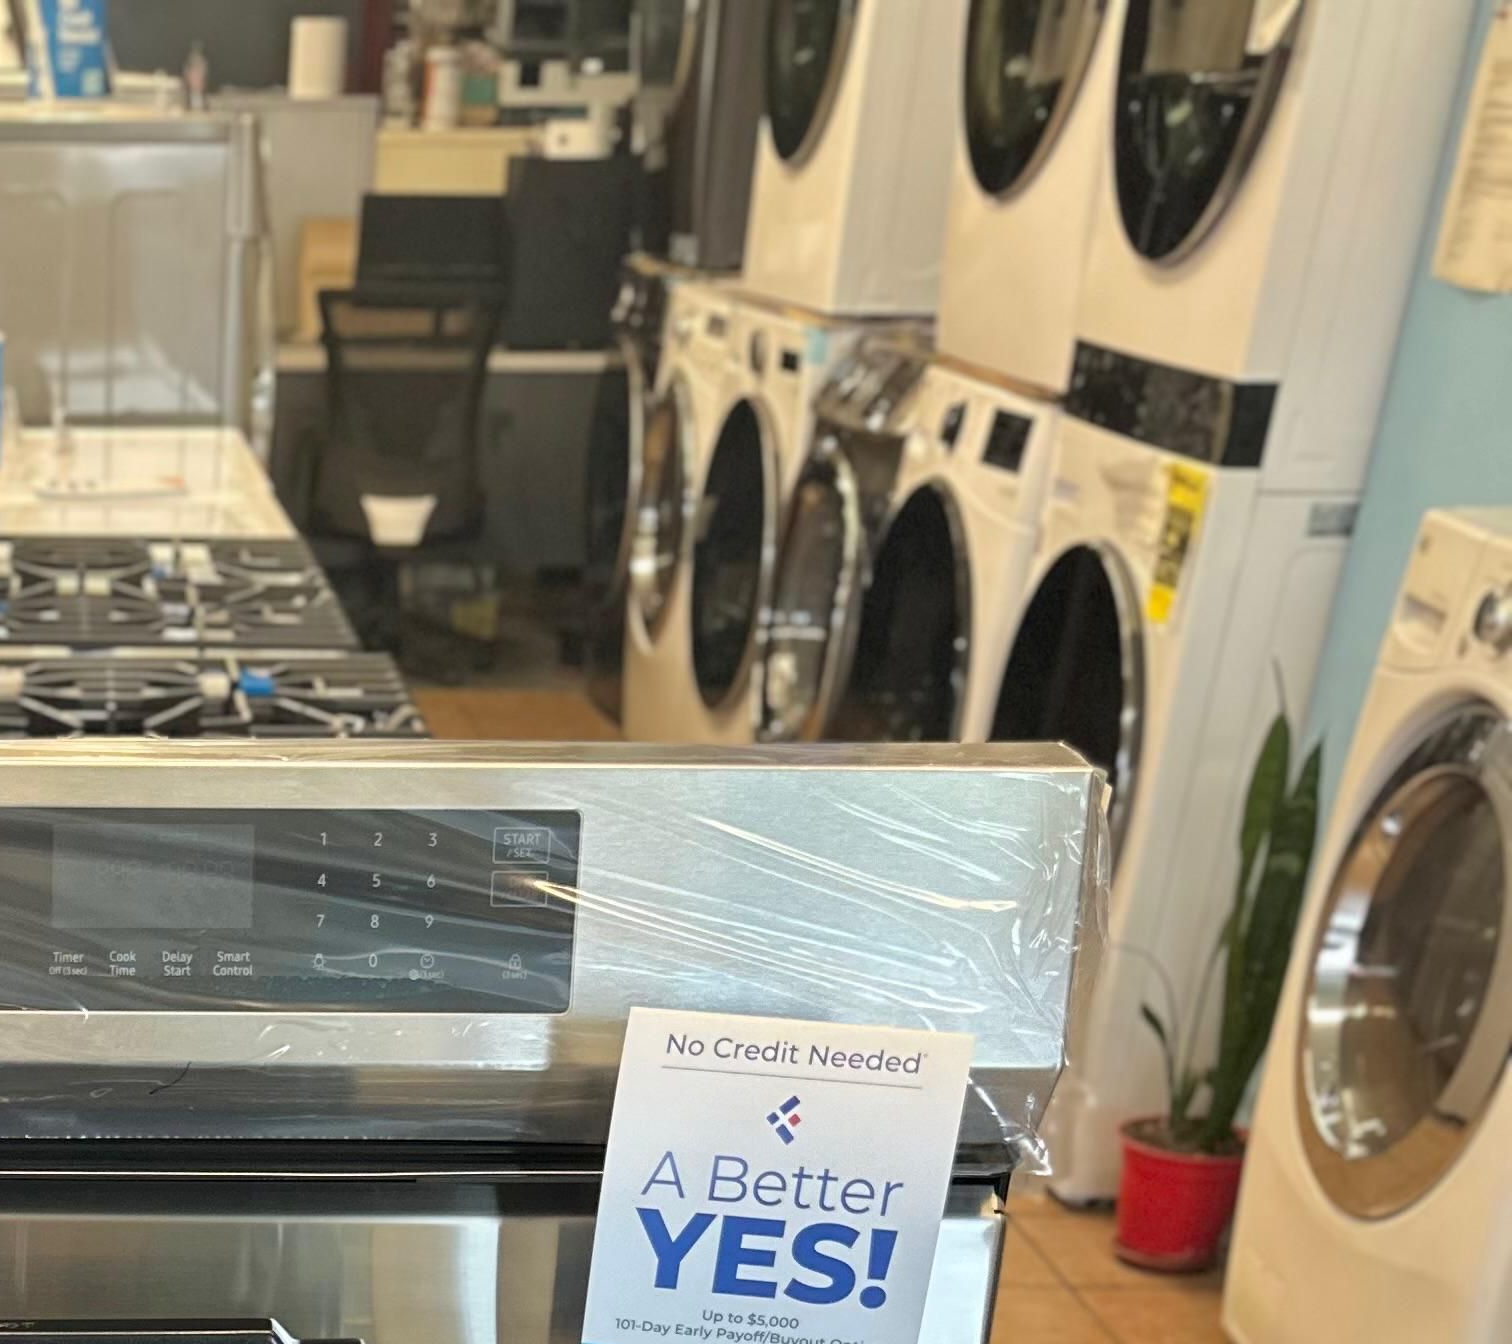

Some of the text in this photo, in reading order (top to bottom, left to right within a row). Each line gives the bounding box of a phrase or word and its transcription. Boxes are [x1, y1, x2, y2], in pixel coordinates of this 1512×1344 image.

[320, 833, 327, 846] 1
[373, 833, 382, 847] 2
[427, 833, 437, 847] 3
[503, 832, 541, 845] START
[317, 874, 326, 888] 4
[372, 874, 381, 888] 5
[426, 874, 436, 889] 6
[316, 915, 325, 928] 7
[370, 915, 379, 929] 8
[425, 915, 434, 929] 9
[52, 951, 84, 964] Timer
[109, 950, 137, 963] Cook
[161, 951, 193, 965] Delay
[216, 950, 250, 963] Smart
[368, 954, 377, 968] 0
[109, 964, 137, 976] Time
[163, 965, 191, 977] Start
[212, 964, 253, 977] Control
[665, 1033, 705, 1057] No
[713, 1037, 799, 1065] Credit
[640, 1150, 904, 1218] A Better
[635, 1206, 899, 1310] YES!
[701, 1309, 800, 1330] Up to $5,000
[614, 1317, 670, 1337] 101-Day
[674, 1323, 713, 1341] Early
